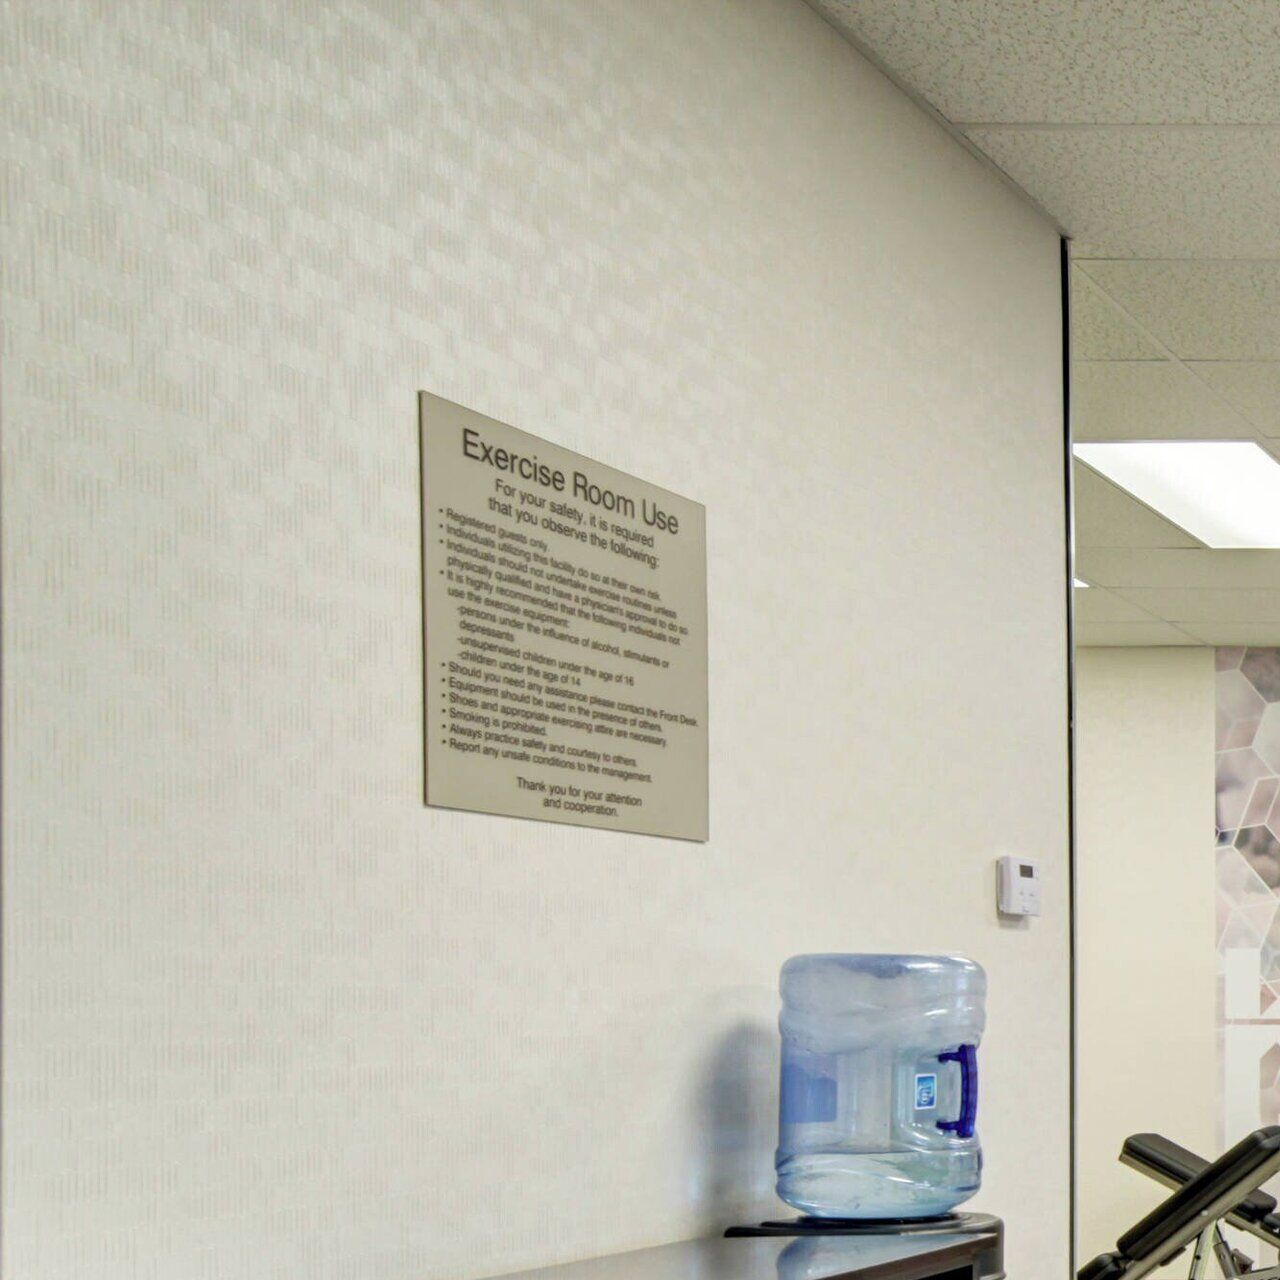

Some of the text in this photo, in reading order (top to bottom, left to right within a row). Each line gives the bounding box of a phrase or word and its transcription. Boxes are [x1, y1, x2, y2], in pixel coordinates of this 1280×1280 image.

[462, 428, 679, 535] Exercise Room Use
[488, 497, 512, 517] that
[515, 508, 538, 525] you
[541, 518, 587, 542] observe
[590, 532, 608, 550] the
[495, 478, 516, 498] For
[519, 491, 546, 508] your
[589, 512, 597, 528] it
[599, 516, 608, 532] is
[611, 524, 654, 548] required
[516, 776, 642, 806] Thank you for your attention
[542, 797, 561, 809] and
